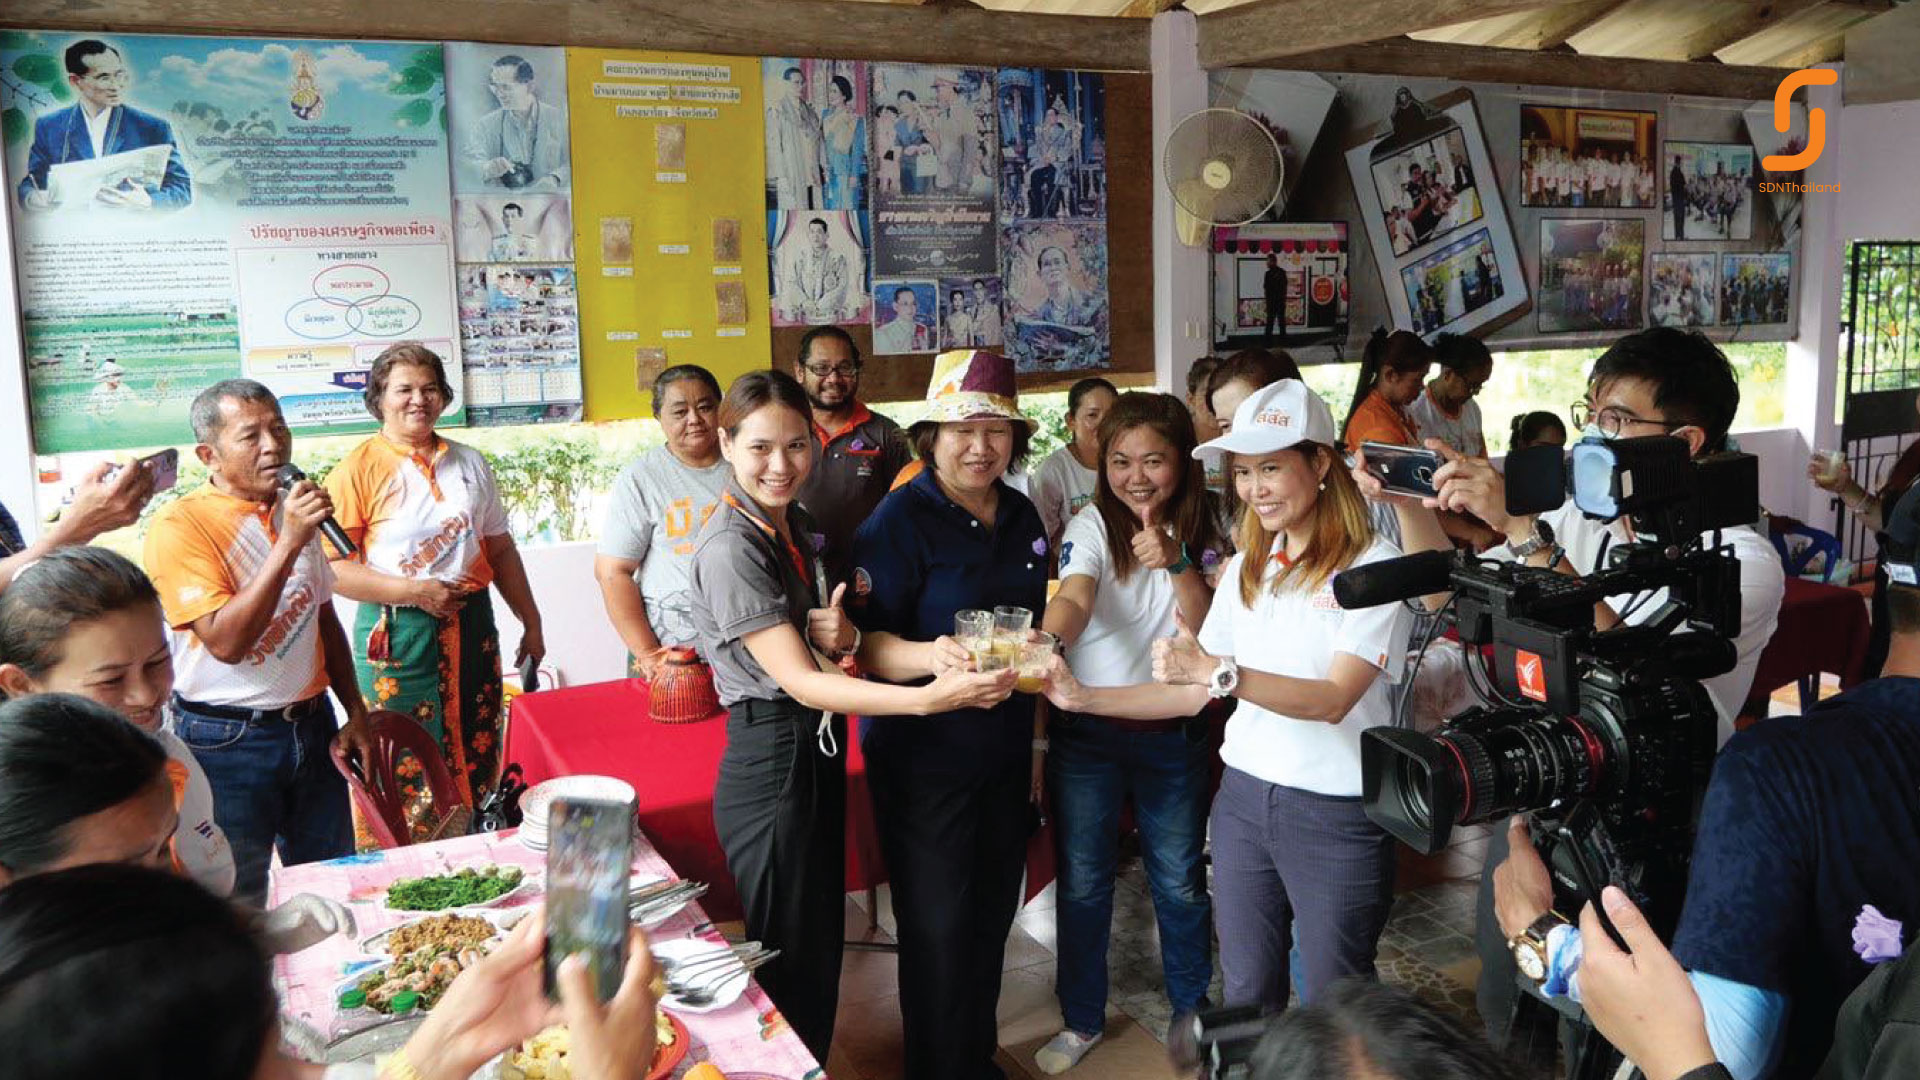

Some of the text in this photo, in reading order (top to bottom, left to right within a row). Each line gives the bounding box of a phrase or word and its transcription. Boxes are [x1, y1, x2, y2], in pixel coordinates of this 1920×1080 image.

[250, 221, 436, 242] ปรัชญาของเศรษฐกิจพอเพียง
[317, 250, 378, 261] ทางสายกลาง
